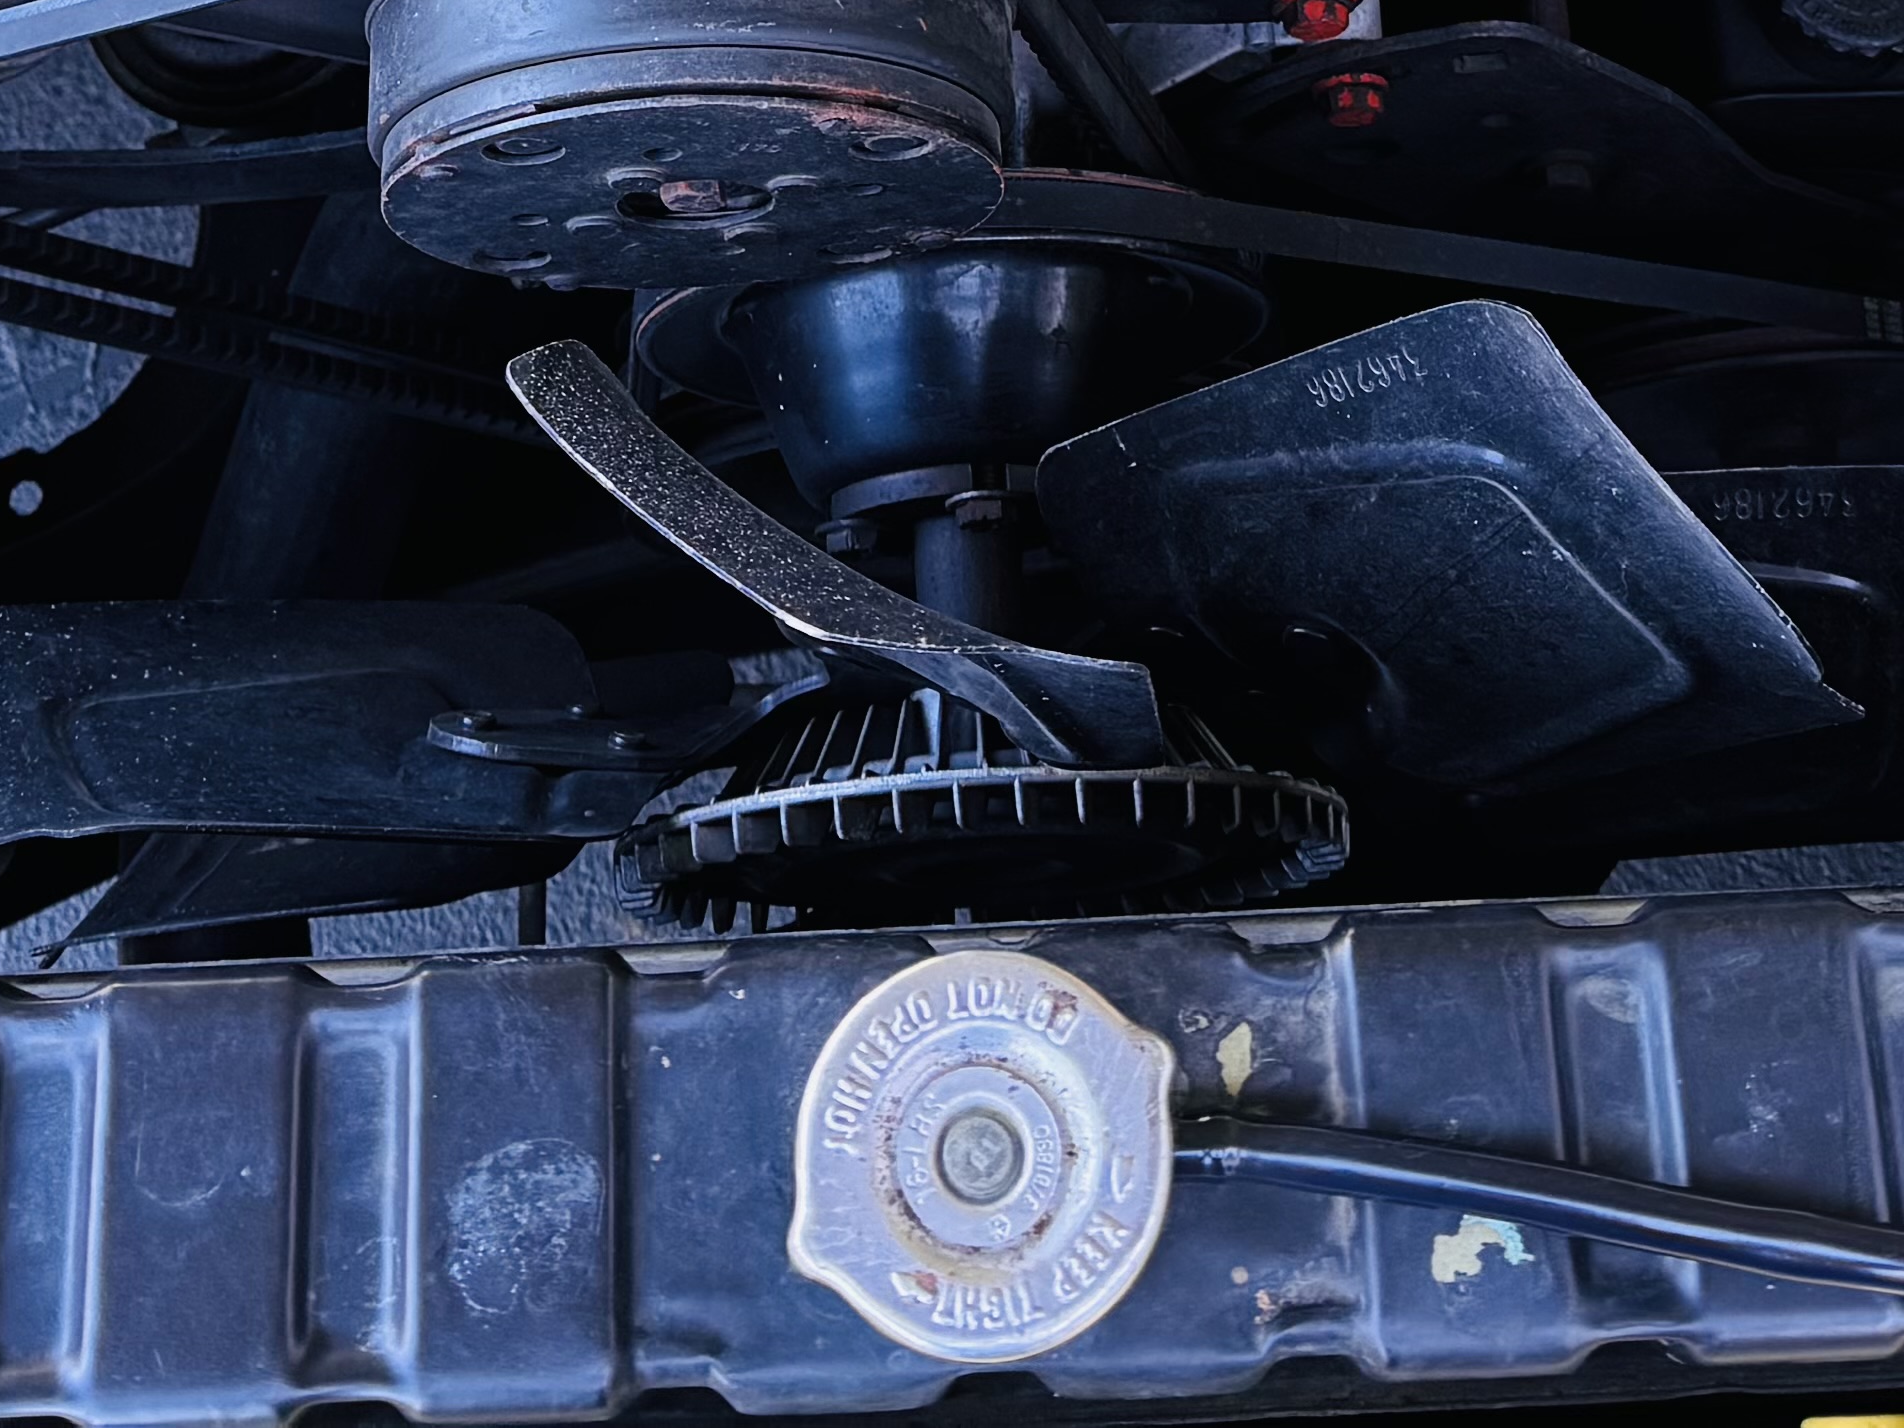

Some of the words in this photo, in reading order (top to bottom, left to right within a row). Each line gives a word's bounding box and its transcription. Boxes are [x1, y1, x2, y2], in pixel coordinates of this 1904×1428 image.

[1305, 344, 1430, 410] 3462186
[847, 989, 937, 1083] OPEN
[1051, 1211, 1128, 1304] KEEP
[930, 1276, 1045, 1332] TIGHT
